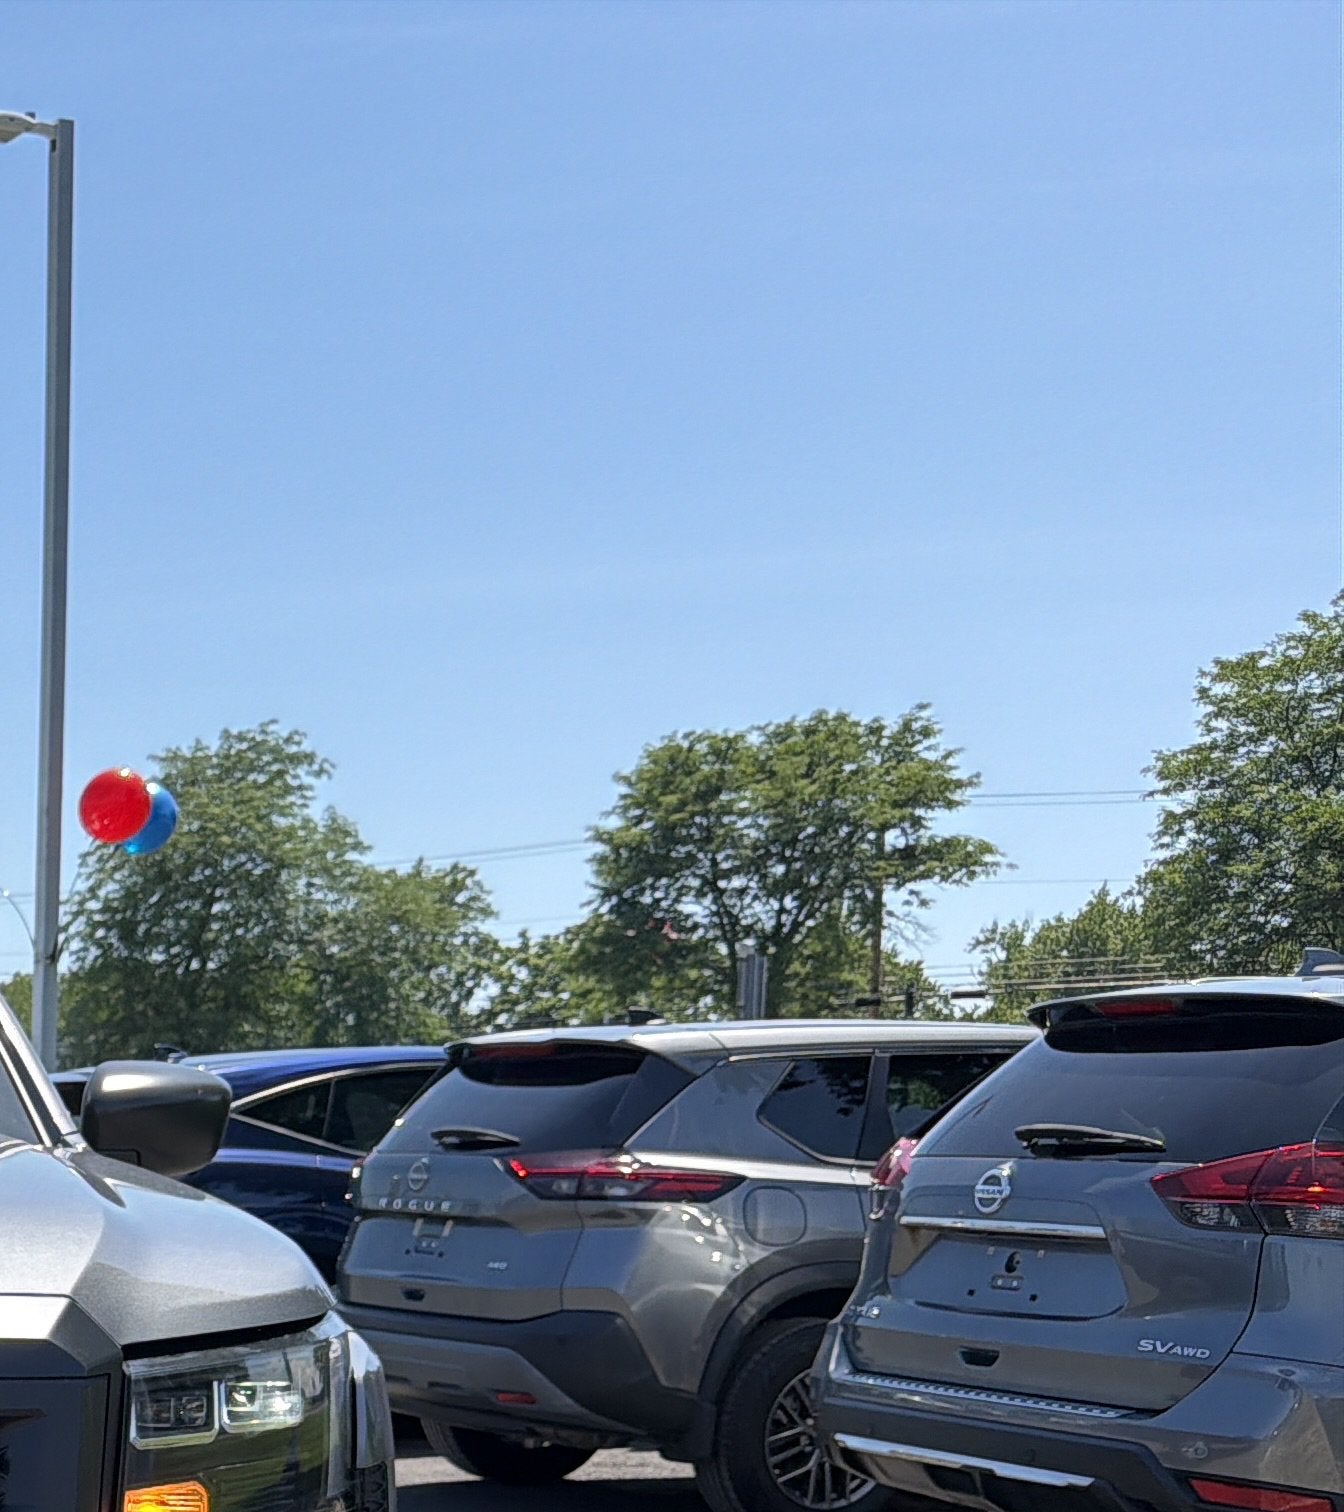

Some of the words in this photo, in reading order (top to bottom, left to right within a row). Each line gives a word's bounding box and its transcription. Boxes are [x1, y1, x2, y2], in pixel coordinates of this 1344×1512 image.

[378, 1198, 452, 1212] ROGUE
[1137, 1339, 1174, 1353] SV
[1169, 1345, 1211, 1359] AWD
